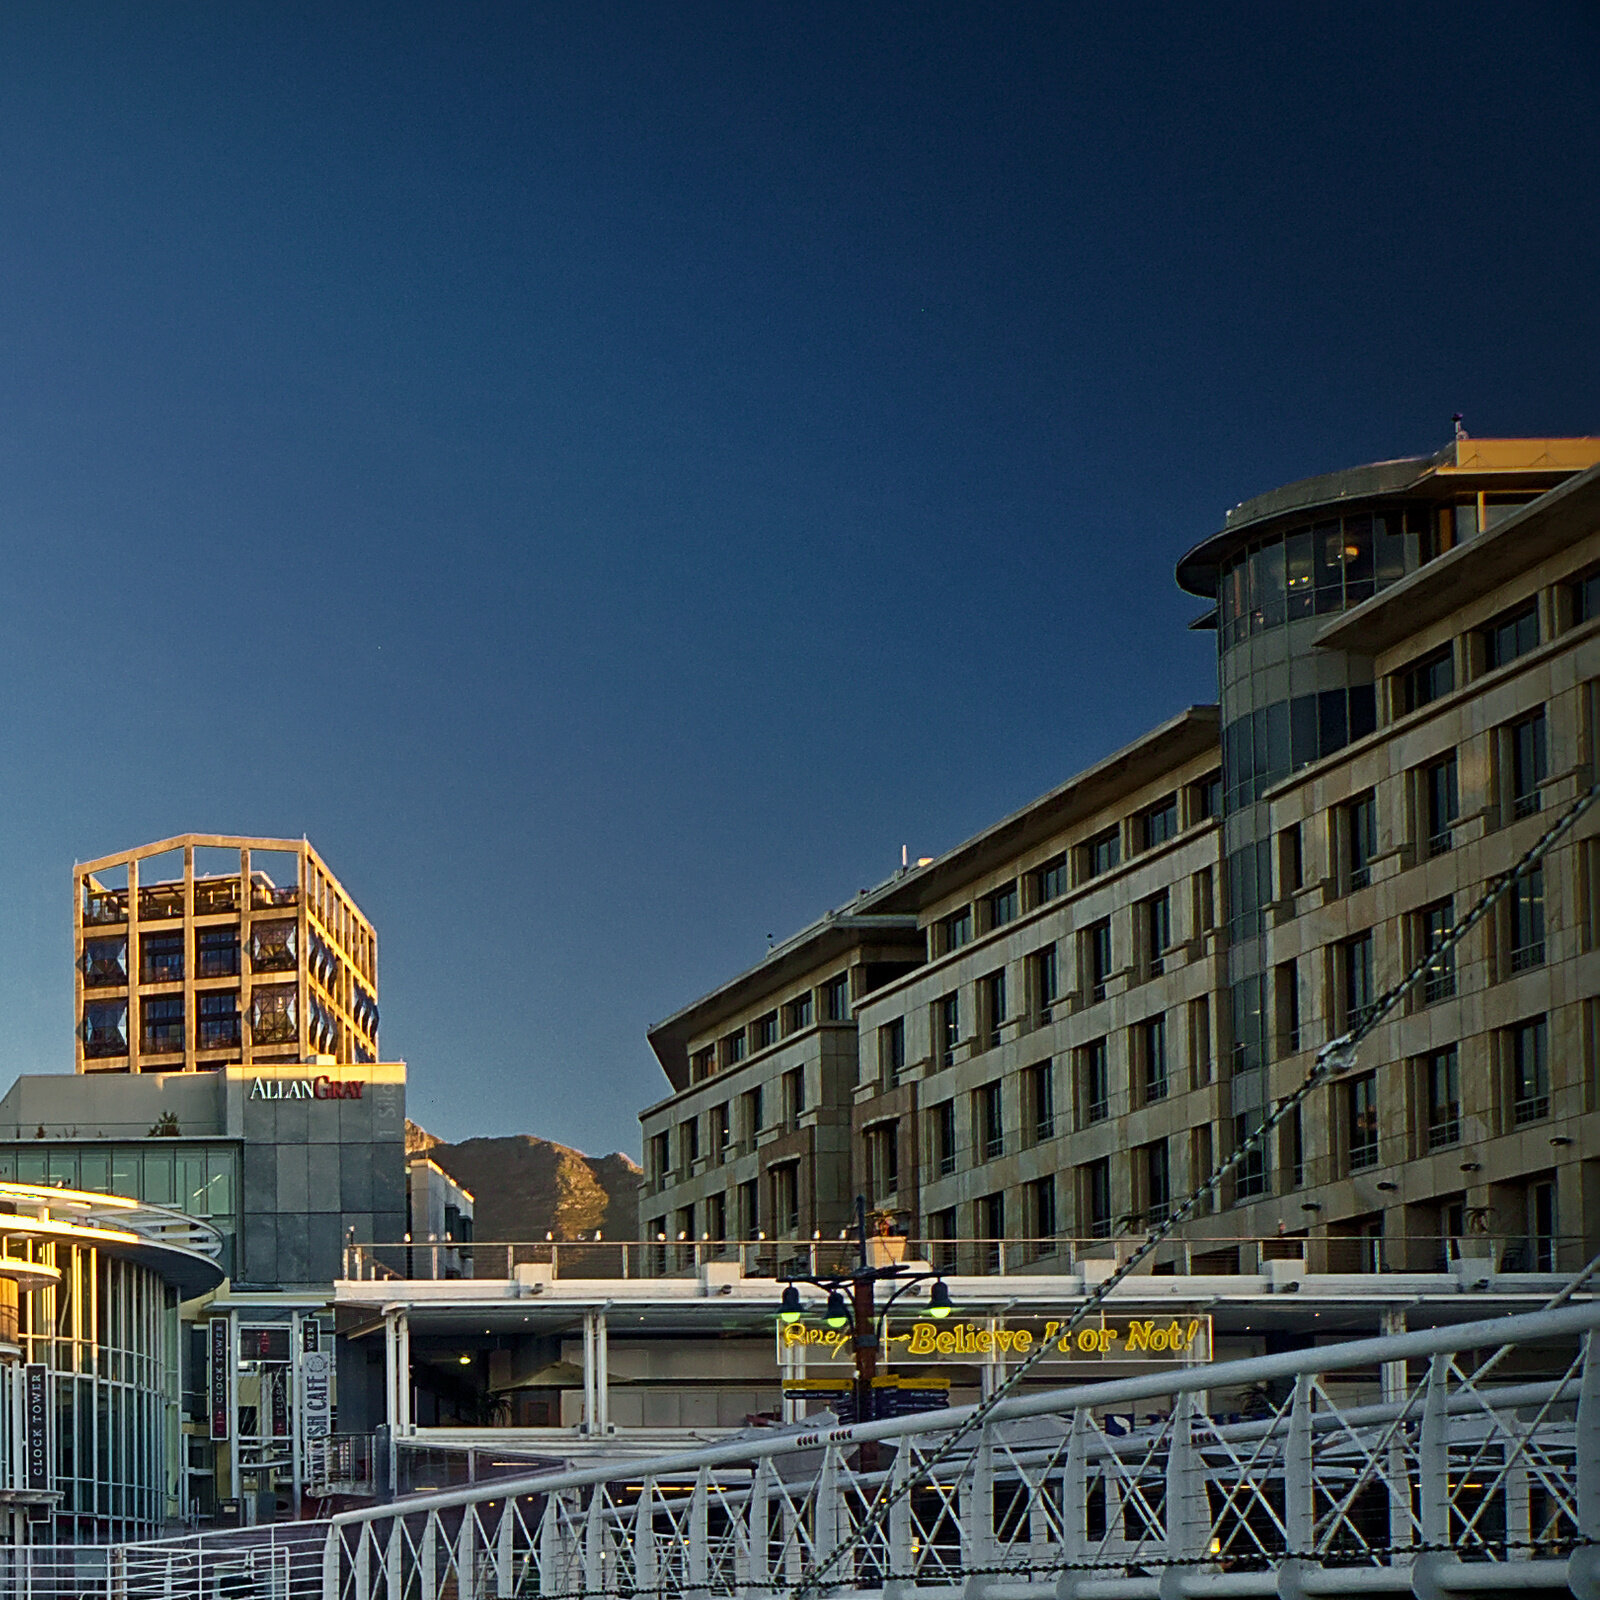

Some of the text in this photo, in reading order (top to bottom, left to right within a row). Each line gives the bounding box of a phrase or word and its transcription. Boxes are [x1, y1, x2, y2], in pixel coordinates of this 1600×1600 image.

[215, 1325, 224, 1404] CLOCK TOWER
[908, 1319, 1199, 1355] Believe It or Not!
[306, 1375, 328, 1412] CAFE
[31, 1374, 42, 1476] CLOCK TOWER
